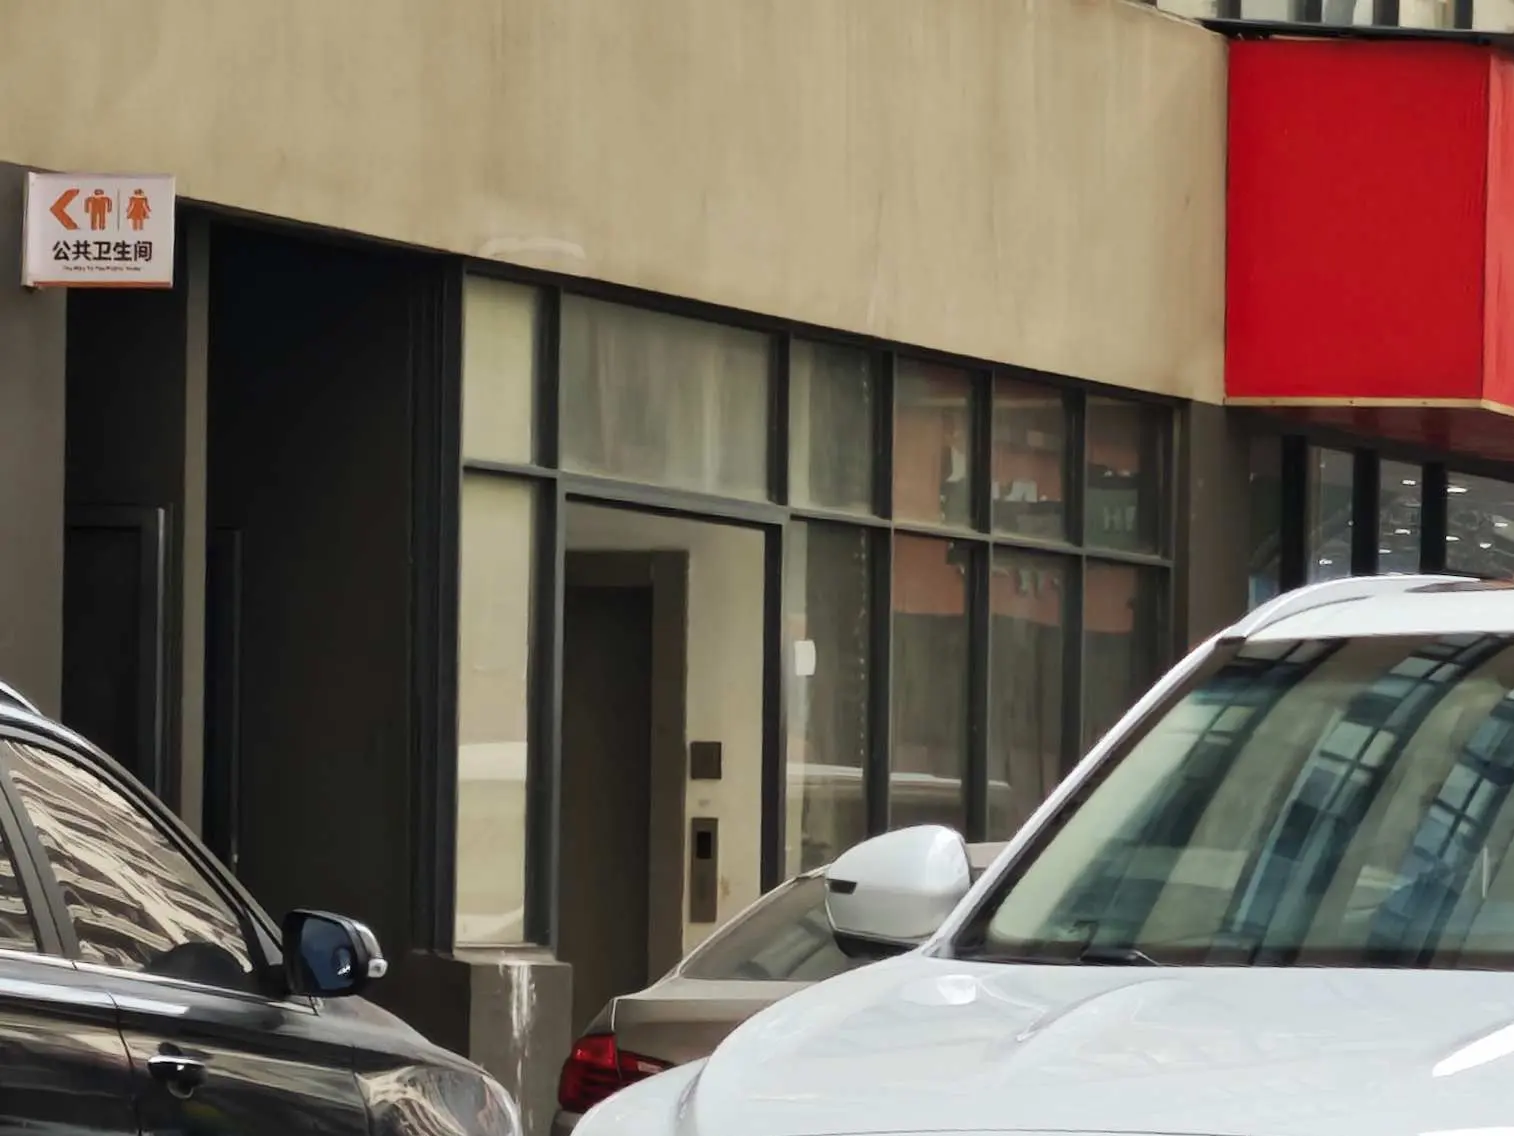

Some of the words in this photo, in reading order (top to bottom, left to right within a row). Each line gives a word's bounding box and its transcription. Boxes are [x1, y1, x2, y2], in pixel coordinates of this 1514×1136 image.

[52, 240, 153, 262] 公共卫生间
